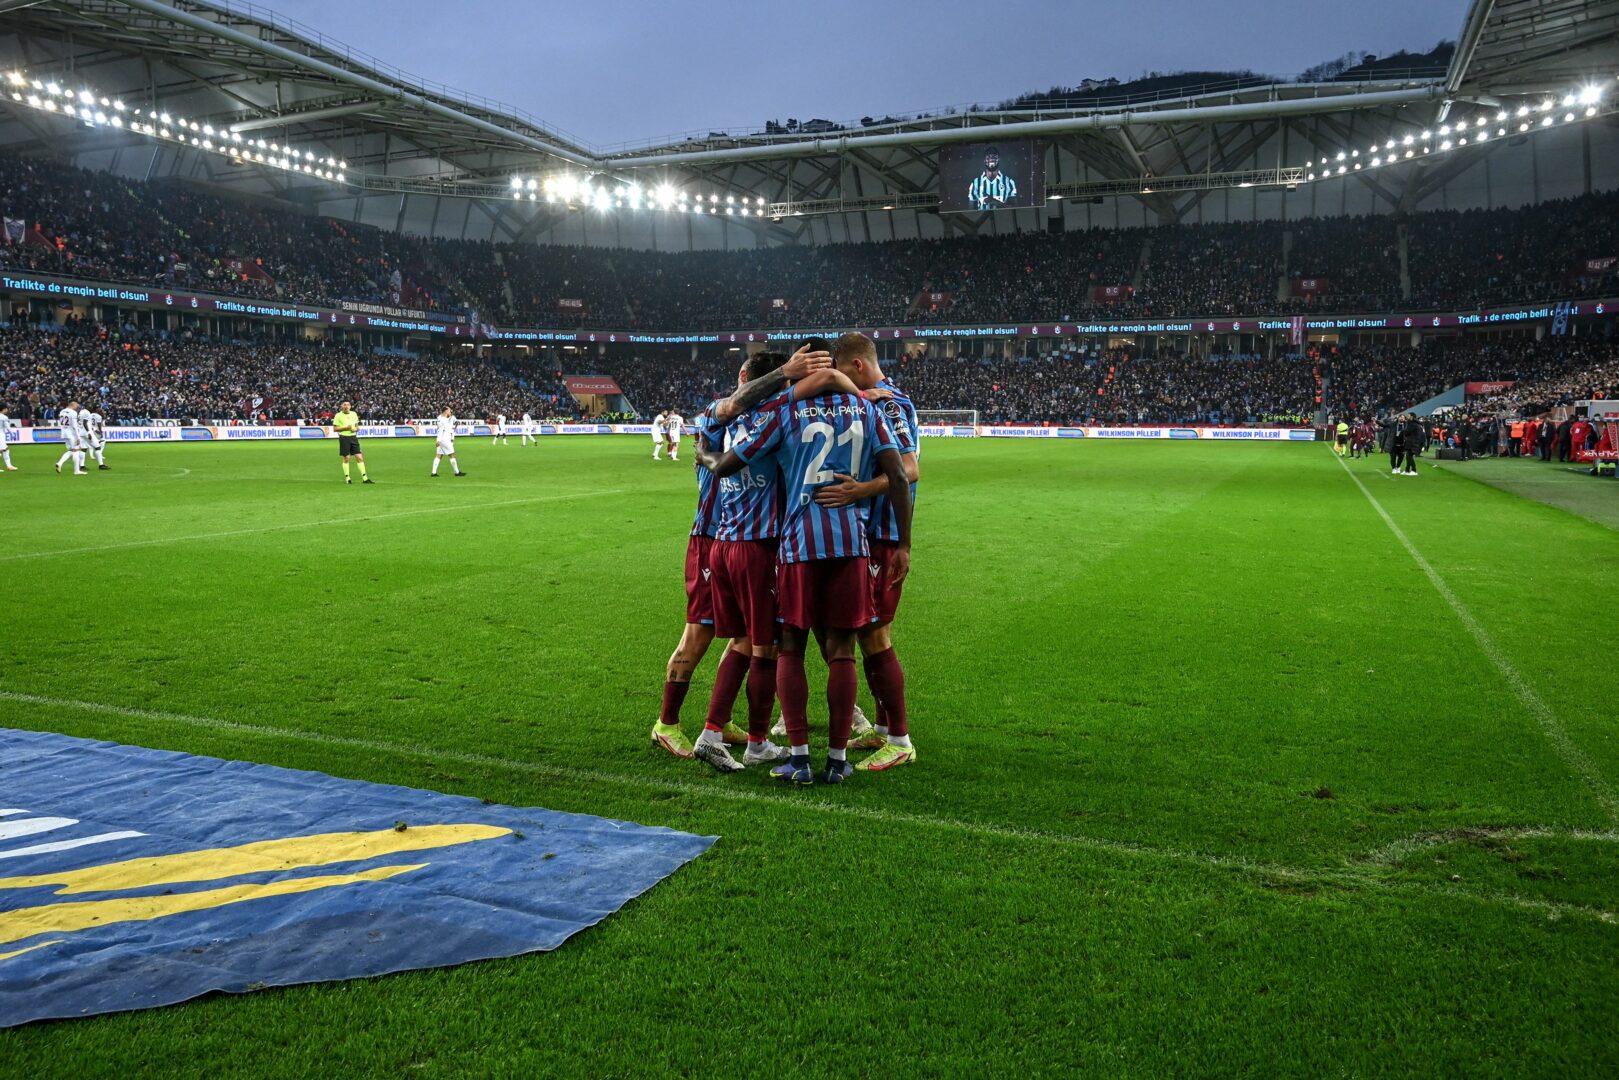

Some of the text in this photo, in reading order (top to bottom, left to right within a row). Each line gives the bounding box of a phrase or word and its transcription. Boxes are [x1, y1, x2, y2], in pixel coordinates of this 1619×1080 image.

[3, 277, 149, 301] Trafikte de rengin belli olsun!
[215, 300, 319, 320] Trafikte de rengin belli olsun!
[1502, 311, 1528, 321] rengin
[1530, 308, 1548, 318] belli
[368, 317, 389, 327] Trafikte
[400, 322, 416, 330] rengin
[418, 322, 429, 330] belli
[430, 324, 446, 333] olsun!
[1120, 324, 1146, 332] rengin
[1306, 320, 1334, 329] rengin
[1358, 319, 1386, 327] olsun!
[514, 332, 537, 340] rengin
[953, 328, 976, 336] rengin
[227, 428, 292, 437] WILKINSON PİLLERİ
[802, 420, 864, 484] 21
